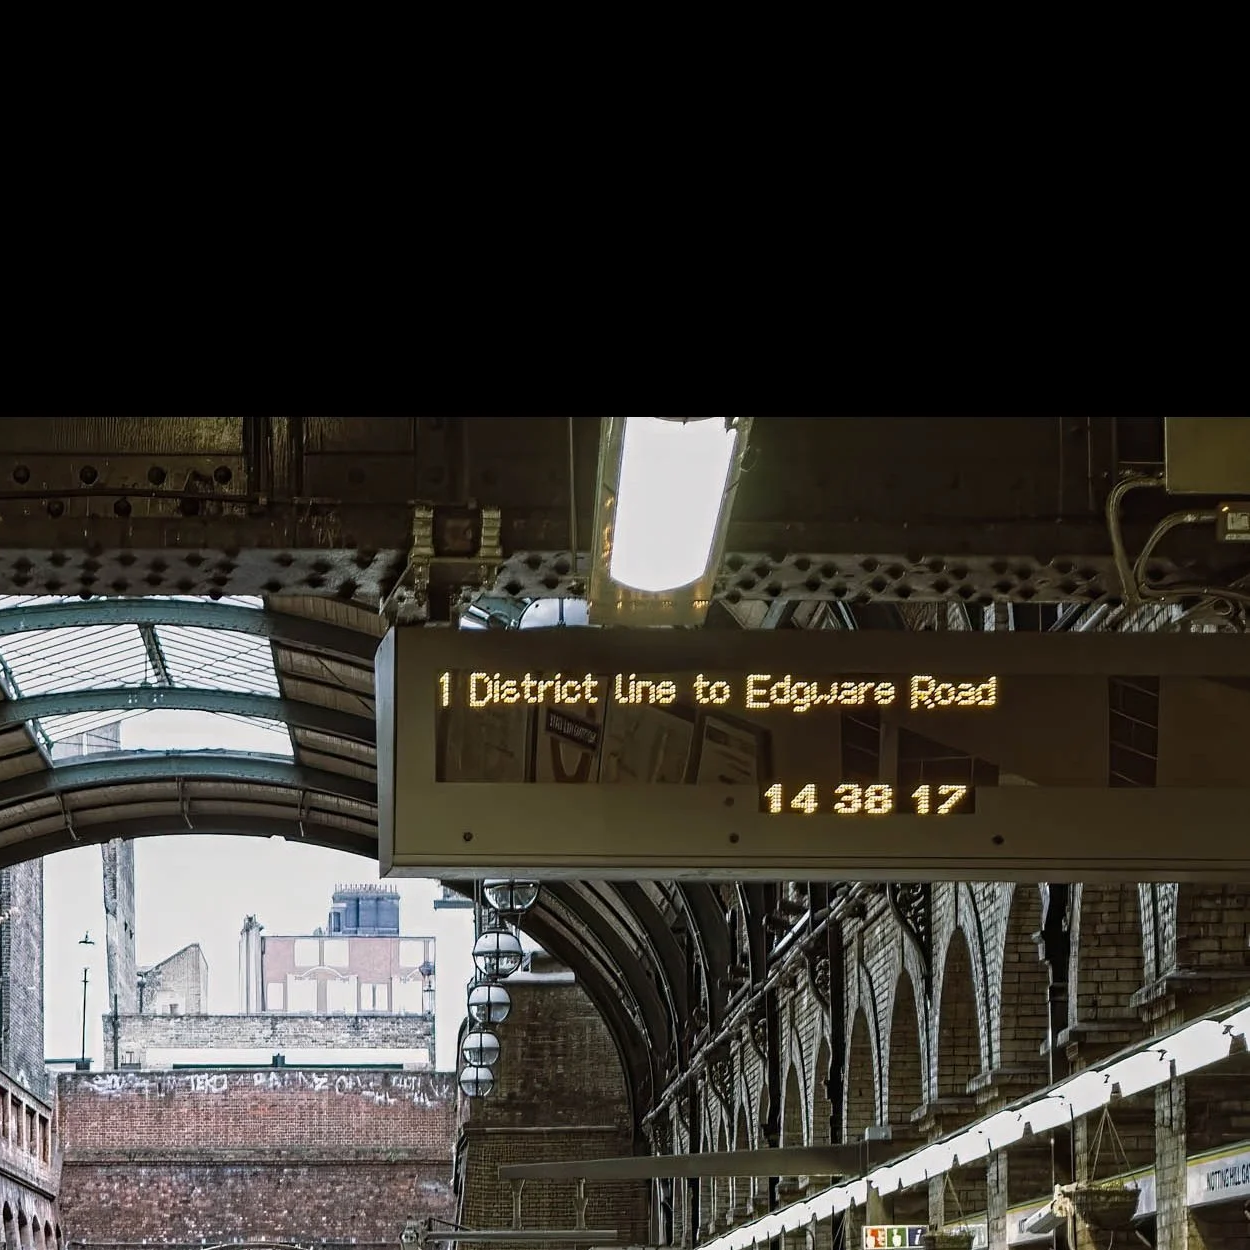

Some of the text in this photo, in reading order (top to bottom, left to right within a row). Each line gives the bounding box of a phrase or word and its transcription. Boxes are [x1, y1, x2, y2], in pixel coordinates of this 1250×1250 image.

[440, 672, 997, 713] 1 District line to Edgware Road
[764, 783, 967, 815] 14 38 17
[1206, 1163, 1250, 1191] NOTTING HILL GA
